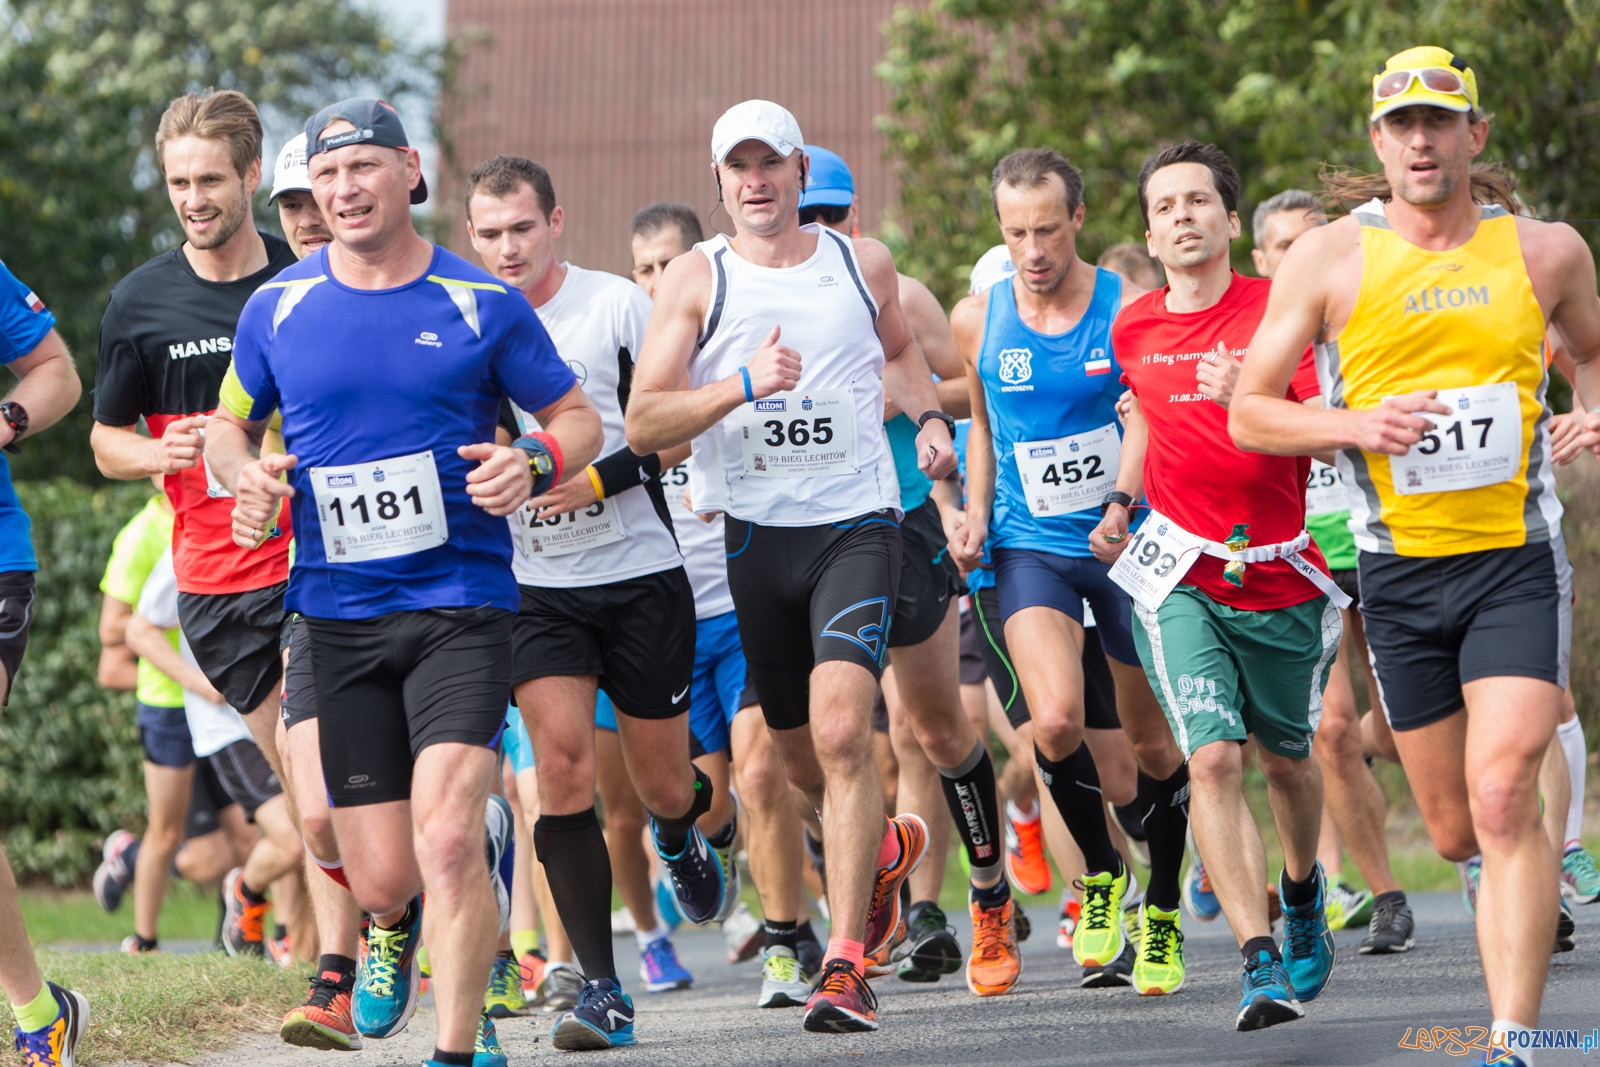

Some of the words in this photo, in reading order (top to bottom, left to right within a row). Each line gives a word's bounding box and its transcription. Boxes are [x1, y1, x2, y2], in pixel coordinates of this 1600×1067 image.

[168, 336, 235, 360] HANS
[1142, 354, 1151, 365] 11
[1153, 353, 1174, 366] Bieg
[764, 417, 833, 447] 365
[1418, 417, 1494, 455] 517
[768, 455, 778, 463] 39
[781, 454, 802, 463] BIEG
[804, 450, 847, 462] LECHITÓW
[1439, 462, 1463, 473] BIEG
[1042, 454, 1105, 486] 452
[329, 485, 423, 526] 1181
[1061, 491, 1080, 500] BIEG
[346, 536, 358, 545] 39
[360, 532, 383, 543] BIEG
[385, 521, 434, 539] LECHITÓW
[552, 531, 570, 541] BIEG
[571, 520, 611, 538] LECHITÓW
[1129, 532, 1177, 578] 199
